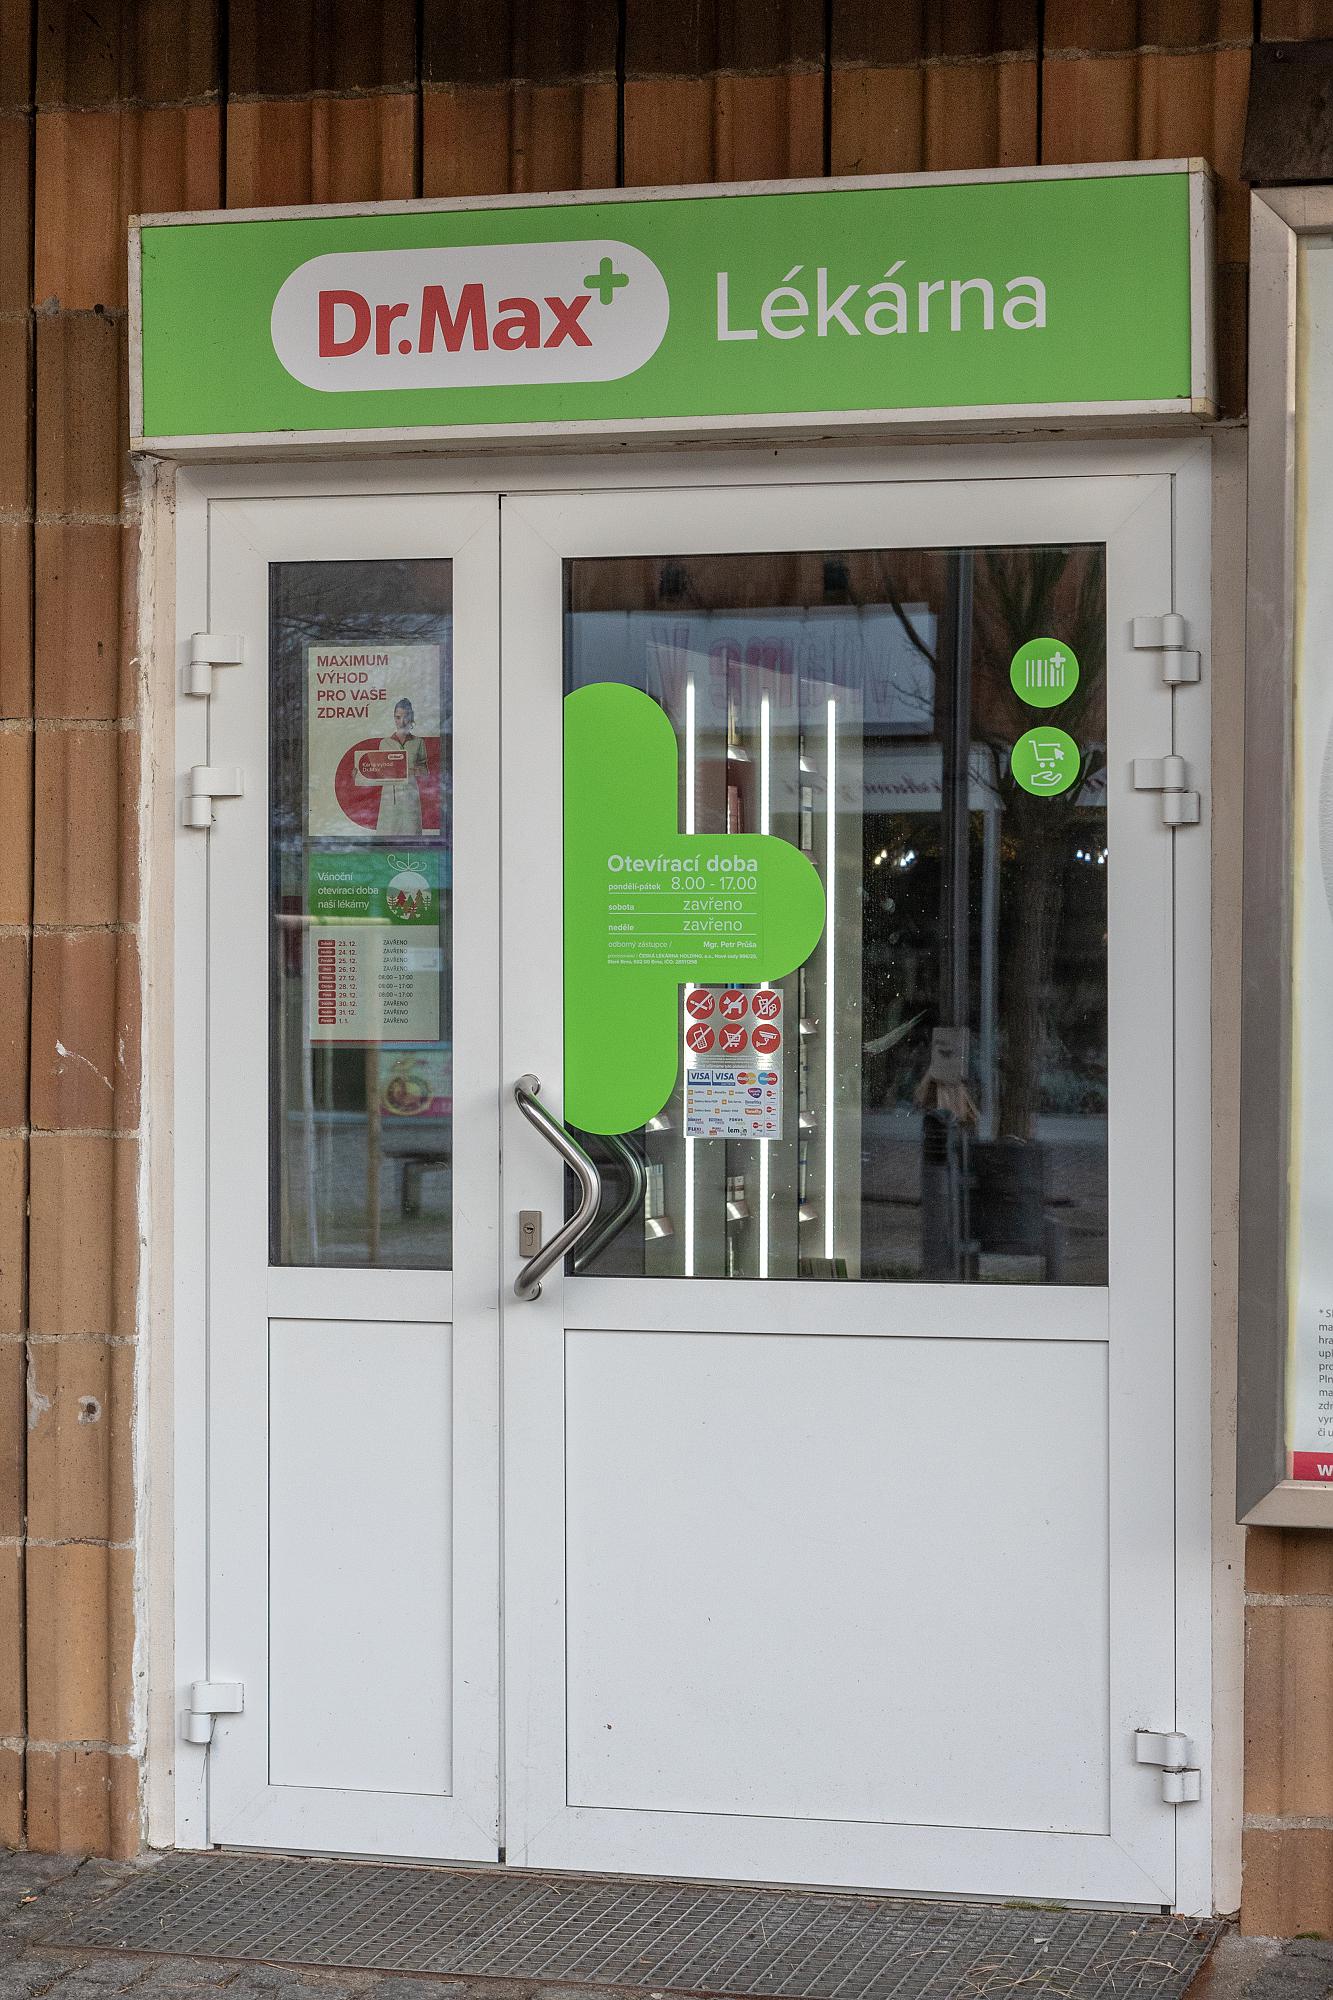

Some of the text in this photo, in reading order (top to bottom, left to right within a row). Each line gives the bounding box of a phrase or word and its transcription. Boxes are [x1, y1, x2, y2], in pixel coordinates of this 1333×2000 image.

[716, 260, 1047, 342] Lékárna
[318, 283, 593, 358] Dr.Max
[317, 654, 389, 667] MAXIMUM
[317, 669, 368, 684] VÝHOD
[317, 686, 387, 701] PRO VAŠE
[317, 704, 370, 719] ZDRAVÍ
[607, 854, 758, 873] Otevírací doba
[317, 871, 354, 882] Vánoční
[608, 882, 661, 891] pondělí-pátek
[671, 876, 705, 890] 8.00
[719, 876, 757, 890] 17.00
[317, 885, 380, 896] otevírací doba
[317, 899, 370, 911] naší lékárny
[608, 897, 743, 911] sobota zavřeno
[683, 917, 743, 932] zavřeno
[703, 941, 719, 950] Mgr.
[691, 1072, 710, 1080] VISA
[715, 1072, 734, 1080] VISA
